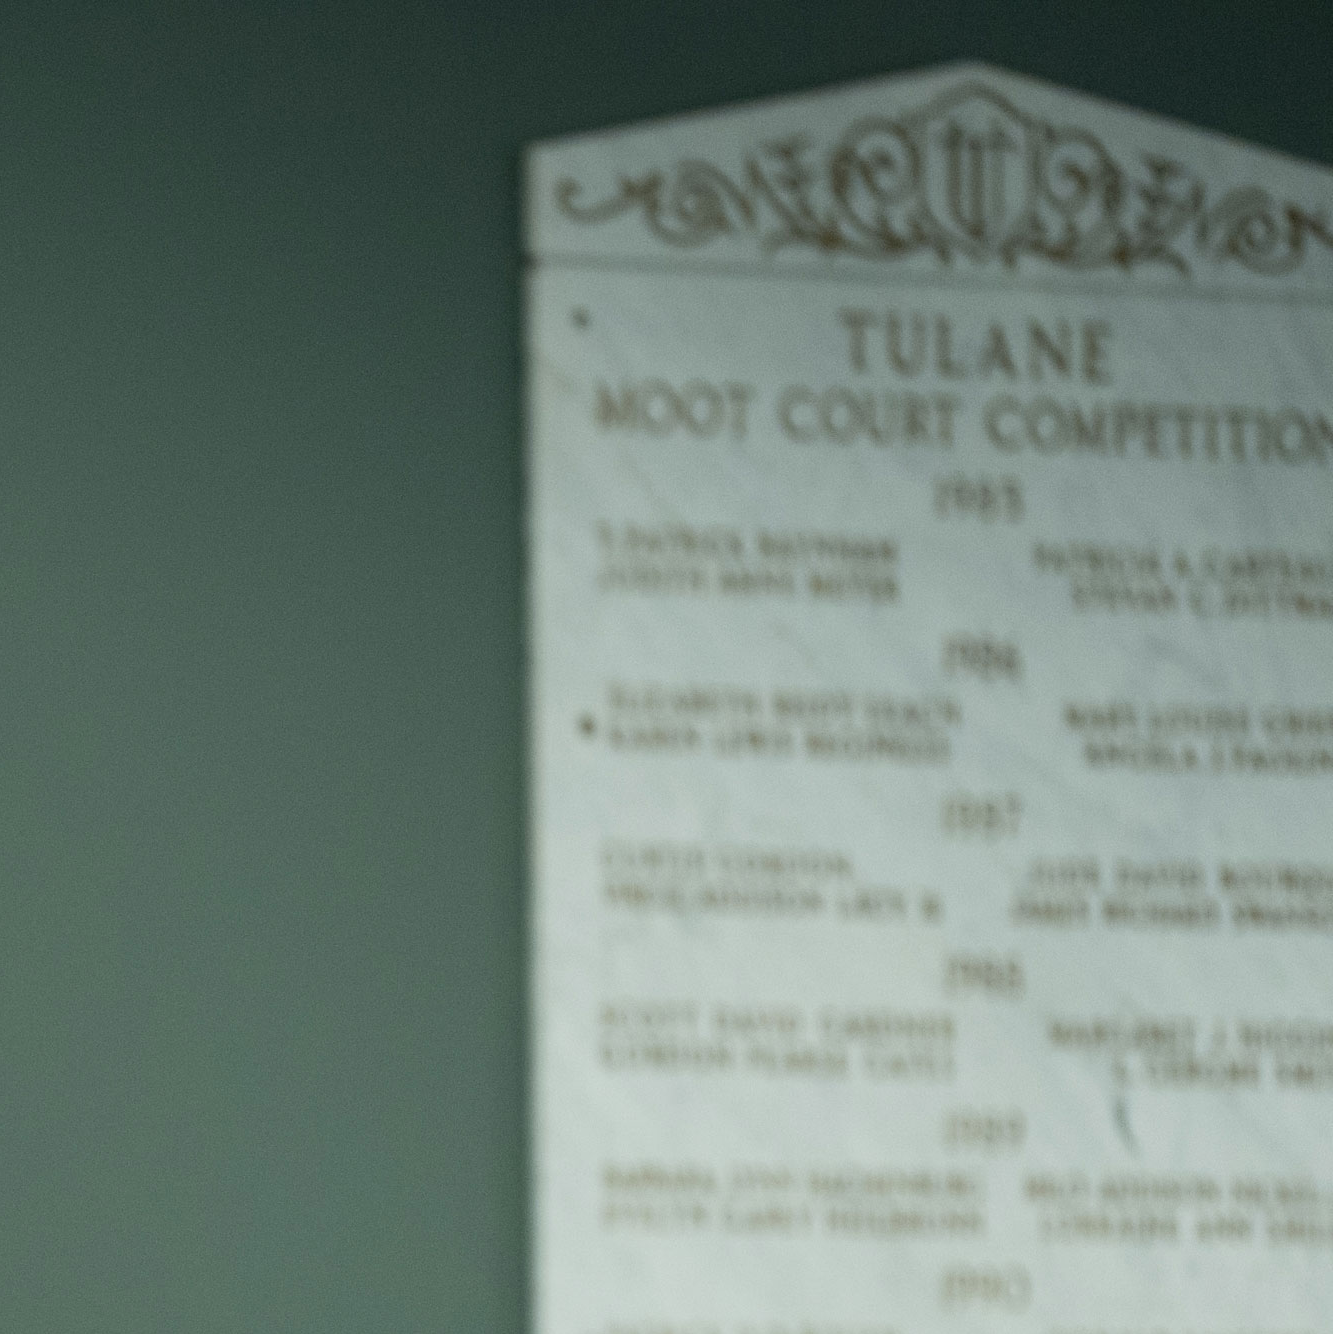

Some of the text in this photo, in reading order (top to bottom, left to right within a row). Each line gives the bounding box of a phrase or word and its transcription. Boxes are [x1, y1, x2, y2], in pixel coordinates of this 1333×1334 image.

[837, 308, 1112, 386] TULANE
[594, 379, 755, 443] MOOT
[776, 385, 959, 448] COURT
